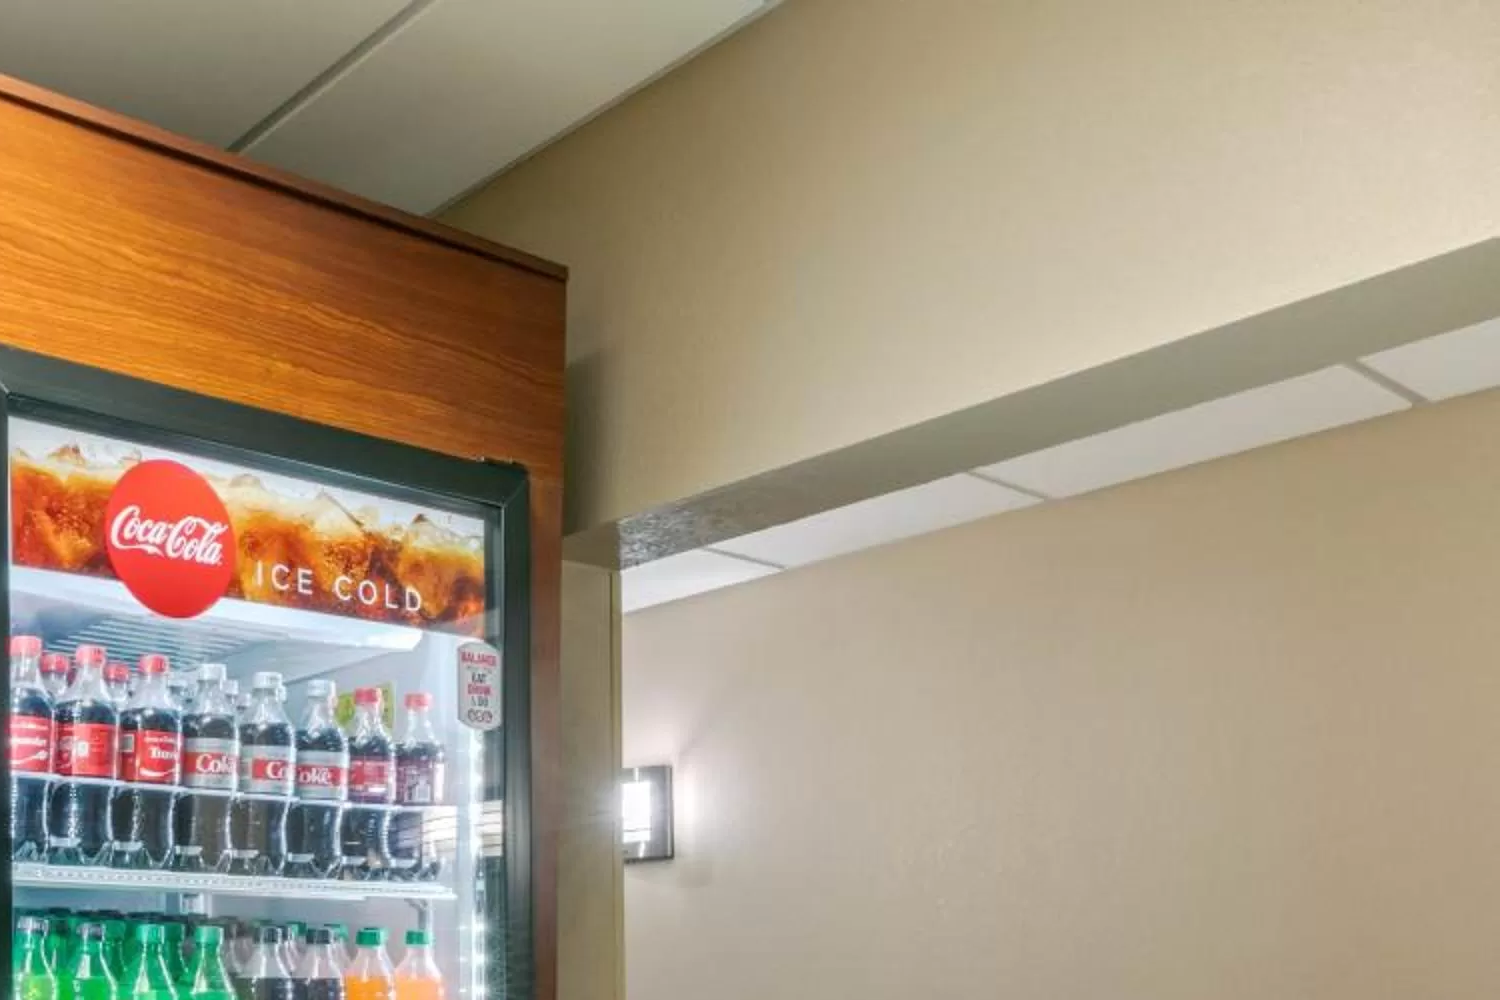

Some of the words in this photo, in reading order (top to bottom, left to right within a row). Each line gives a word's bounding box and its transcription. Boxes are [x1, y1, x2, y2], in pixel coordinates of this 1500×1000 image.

[111, 505, 230, 566] Coca-Cola
[255, 565, 313, 596] ICE
[333, 575, 423, 613] COLD
[195, 753, 237, 776] Cok
[294, 766, 333, 785] oke
